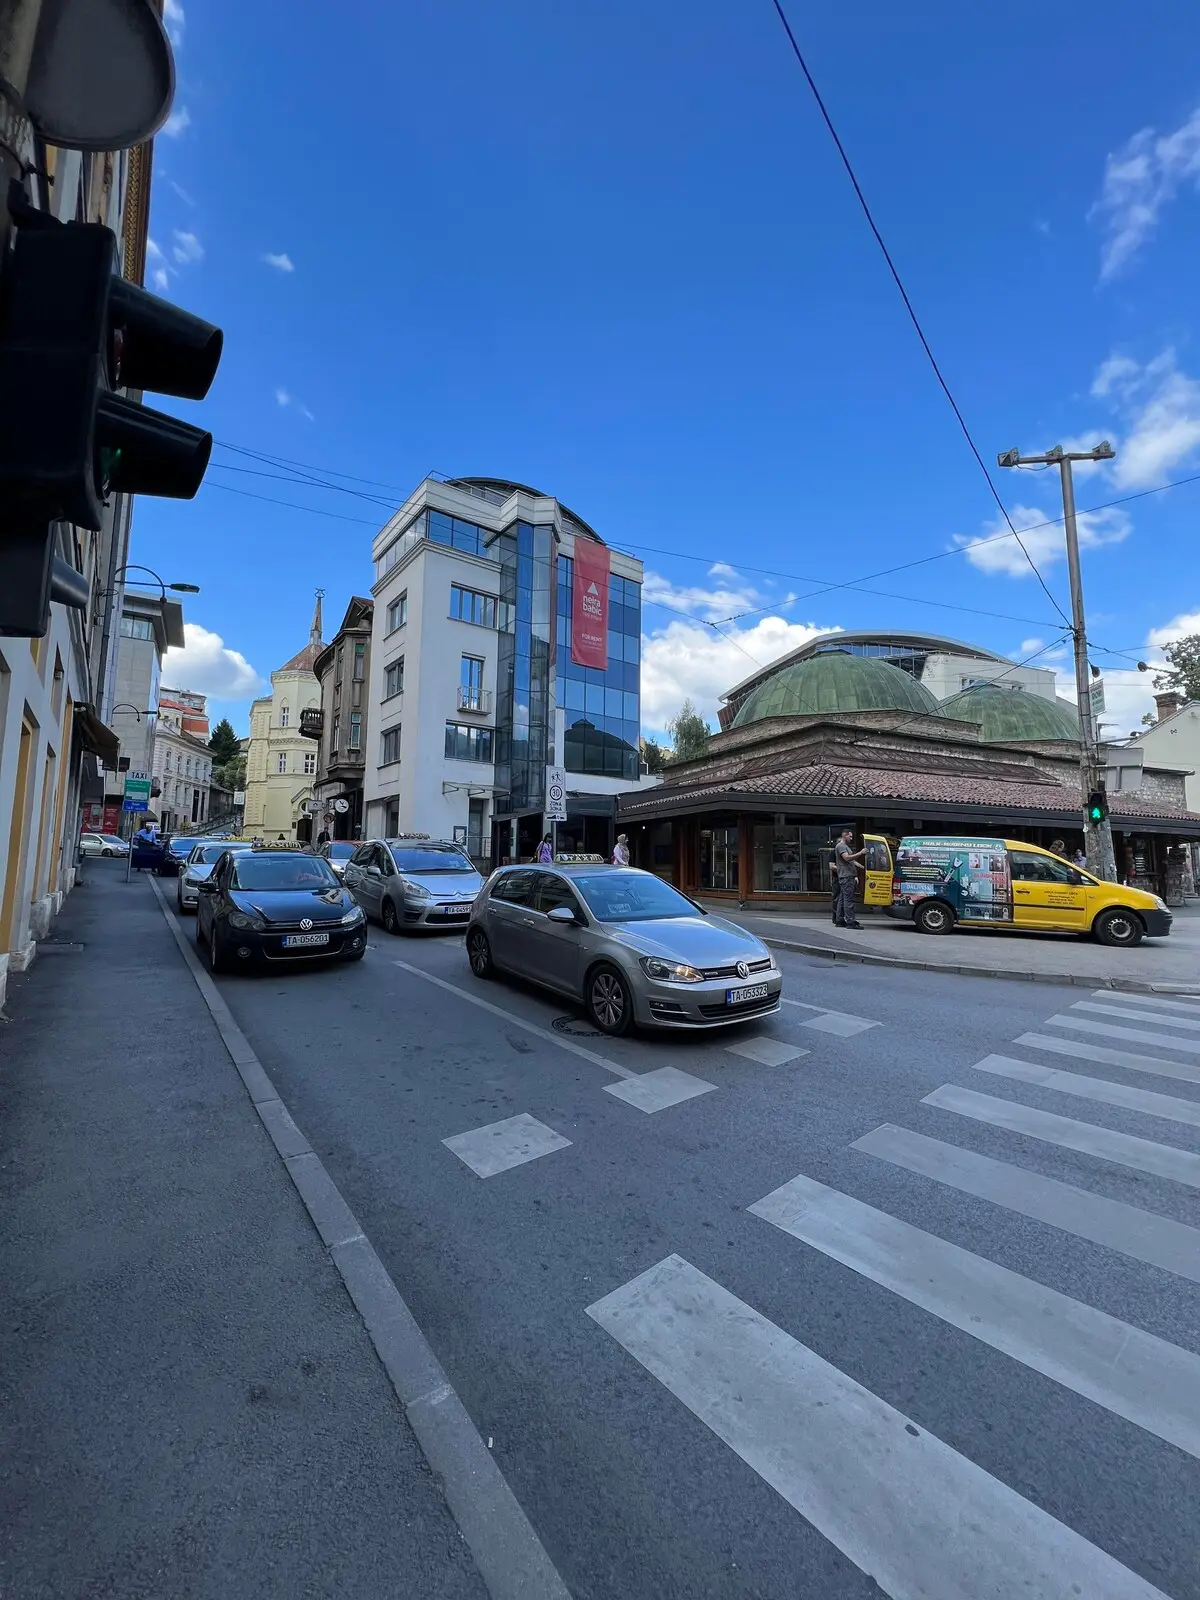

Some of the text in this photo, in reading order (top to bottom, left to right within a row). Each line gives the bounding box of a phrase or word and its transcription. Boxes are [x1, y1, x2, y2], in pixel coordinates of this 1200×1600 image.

[583, 596, 601, 607] neira
[131, 771, 147, 780] TAXI
[551, 788, 561, 798] 30
[287, 934, 329, 945] TA-056201
[731, 985, 767, 1002] TA-053323
